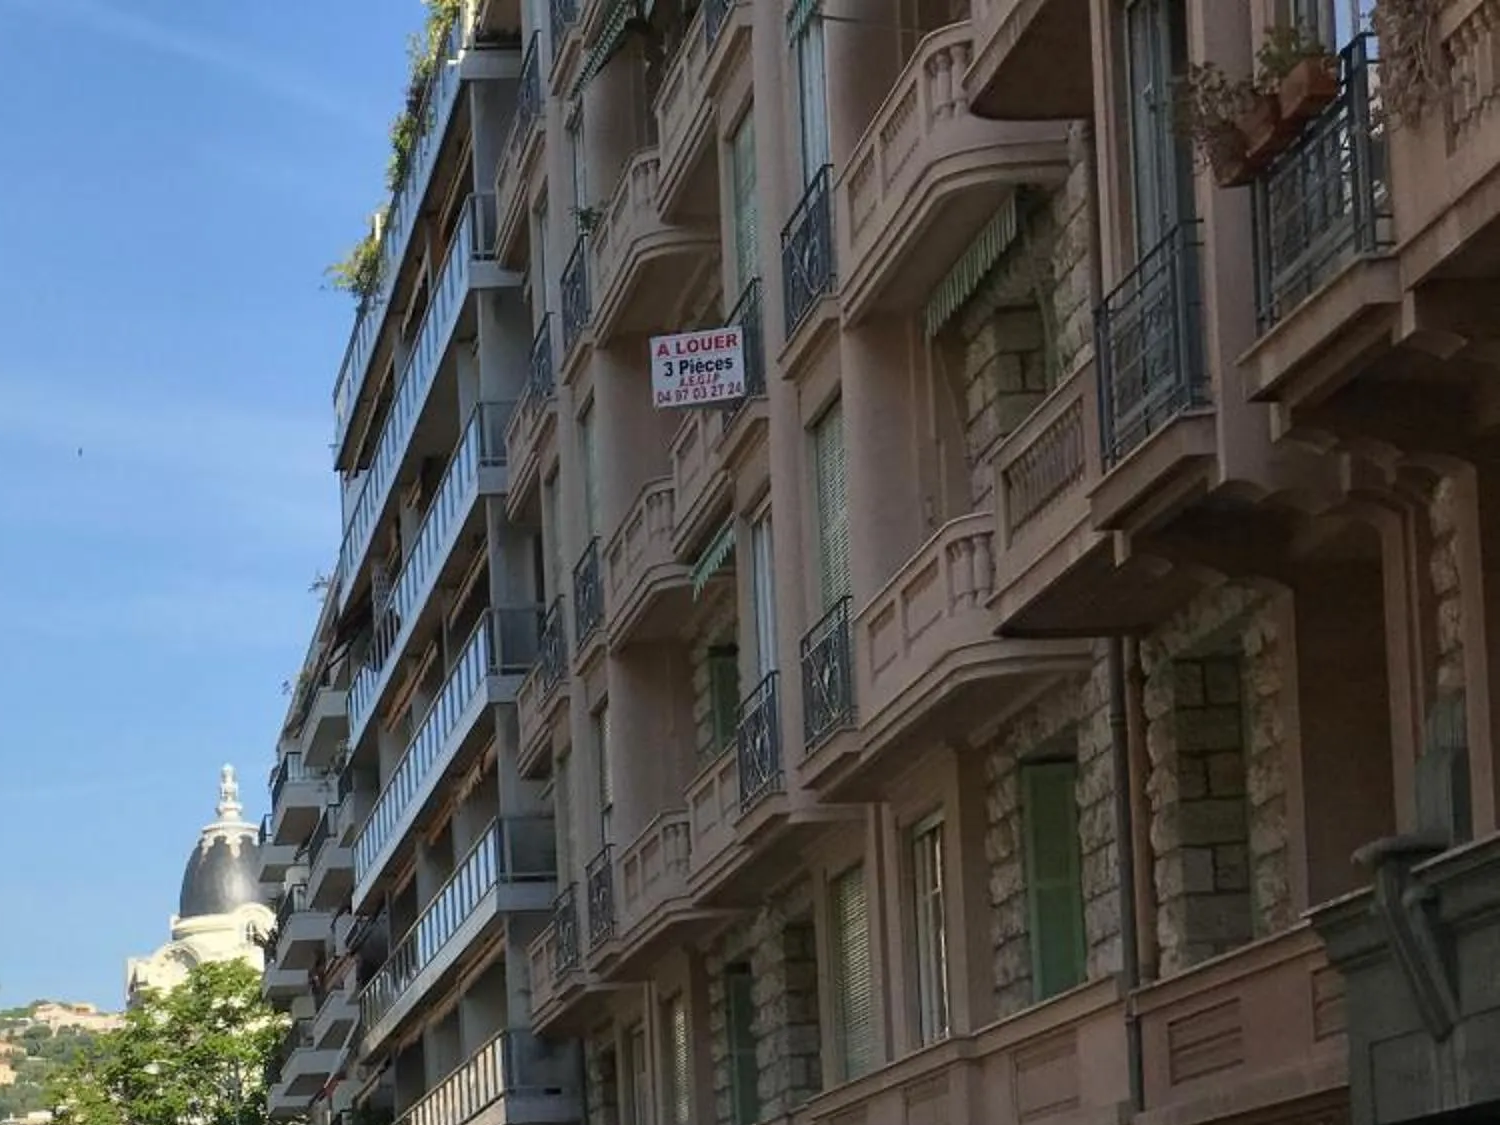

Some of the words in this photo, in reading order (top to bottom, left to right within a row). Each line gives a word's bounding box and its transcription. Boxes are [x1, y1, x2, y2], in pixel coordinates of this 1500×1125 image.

[657, 343, 670, 357] A
[676, 333, 738, 355] LOUER
[663, 361, 674, 377] 3
